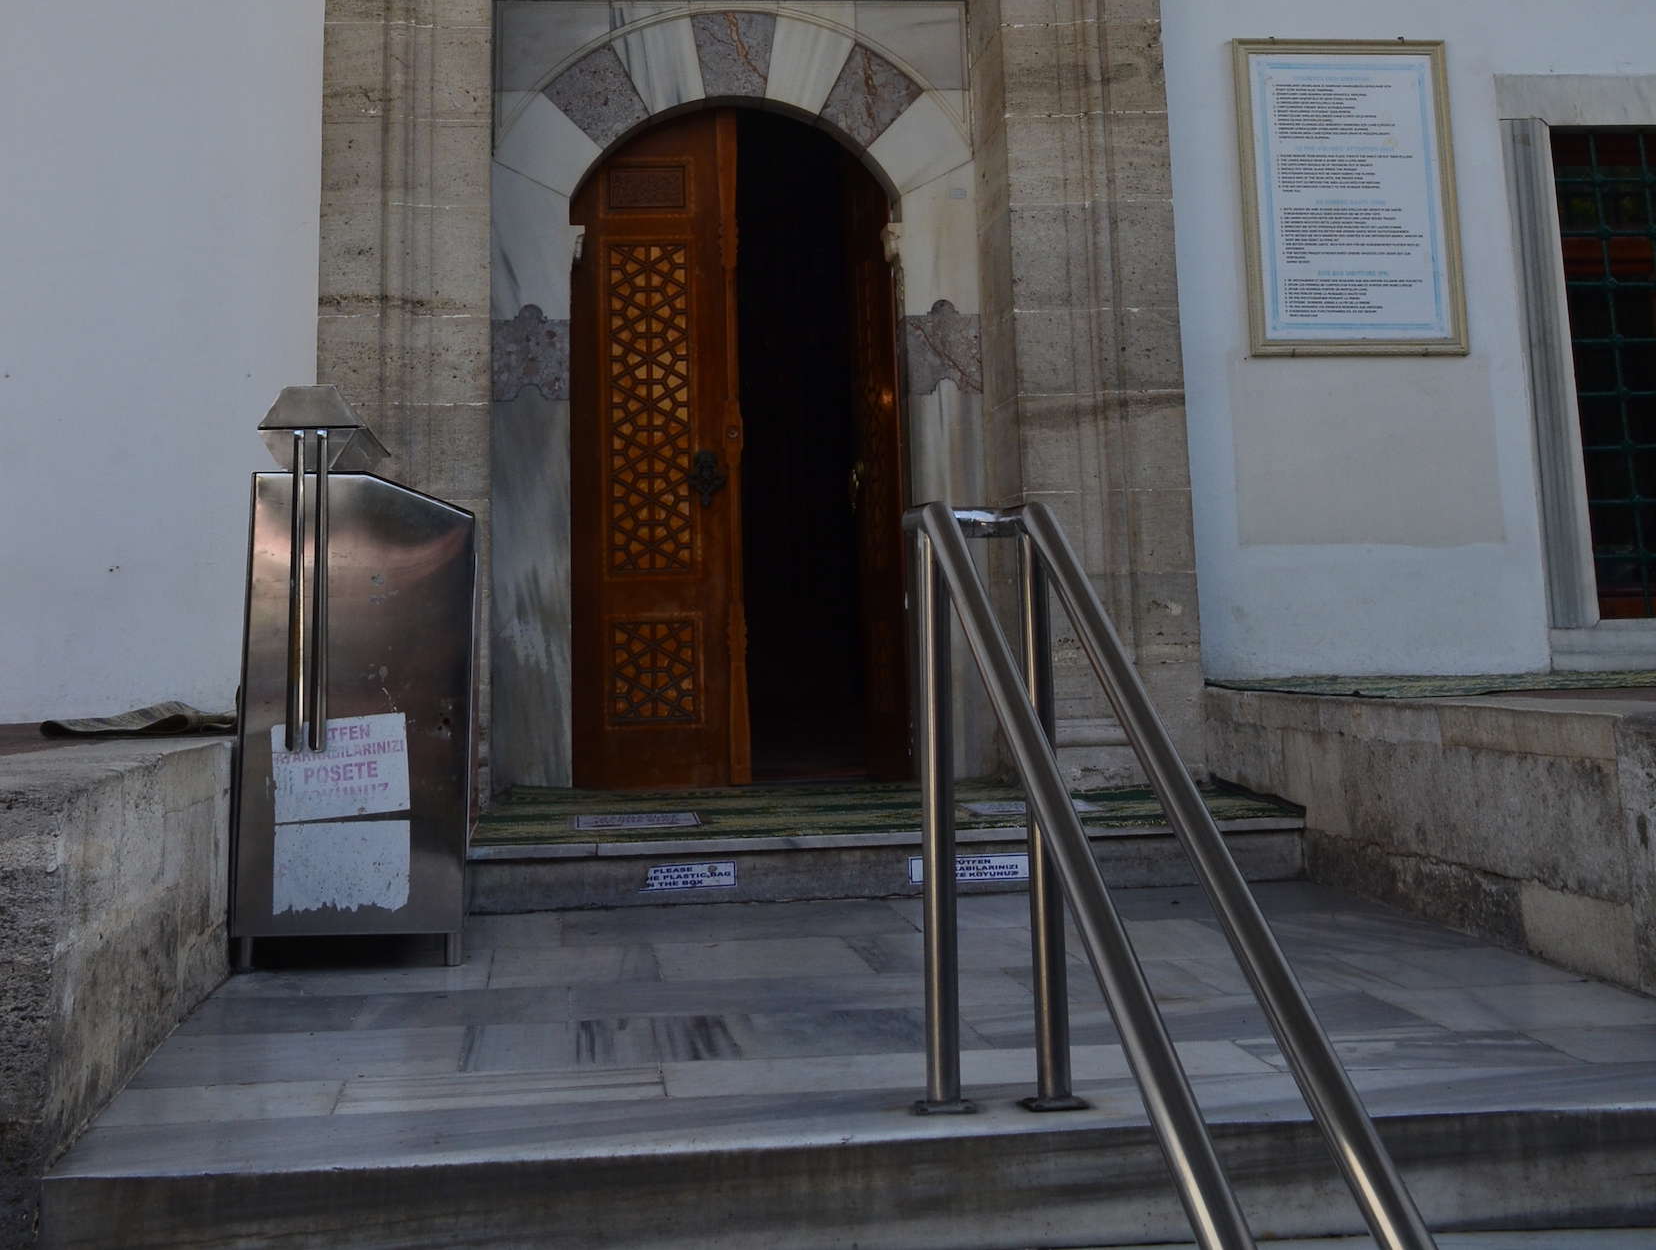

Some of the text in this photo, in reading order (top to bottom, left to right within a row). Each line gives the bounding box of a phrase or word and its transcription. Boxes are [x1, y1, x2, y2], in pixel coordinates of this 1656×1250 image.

[325, 724, 371, 741] TFEN
[653, 866, 693, 874] PLEASE
[663, 872, 707, 880] PLASTIC
